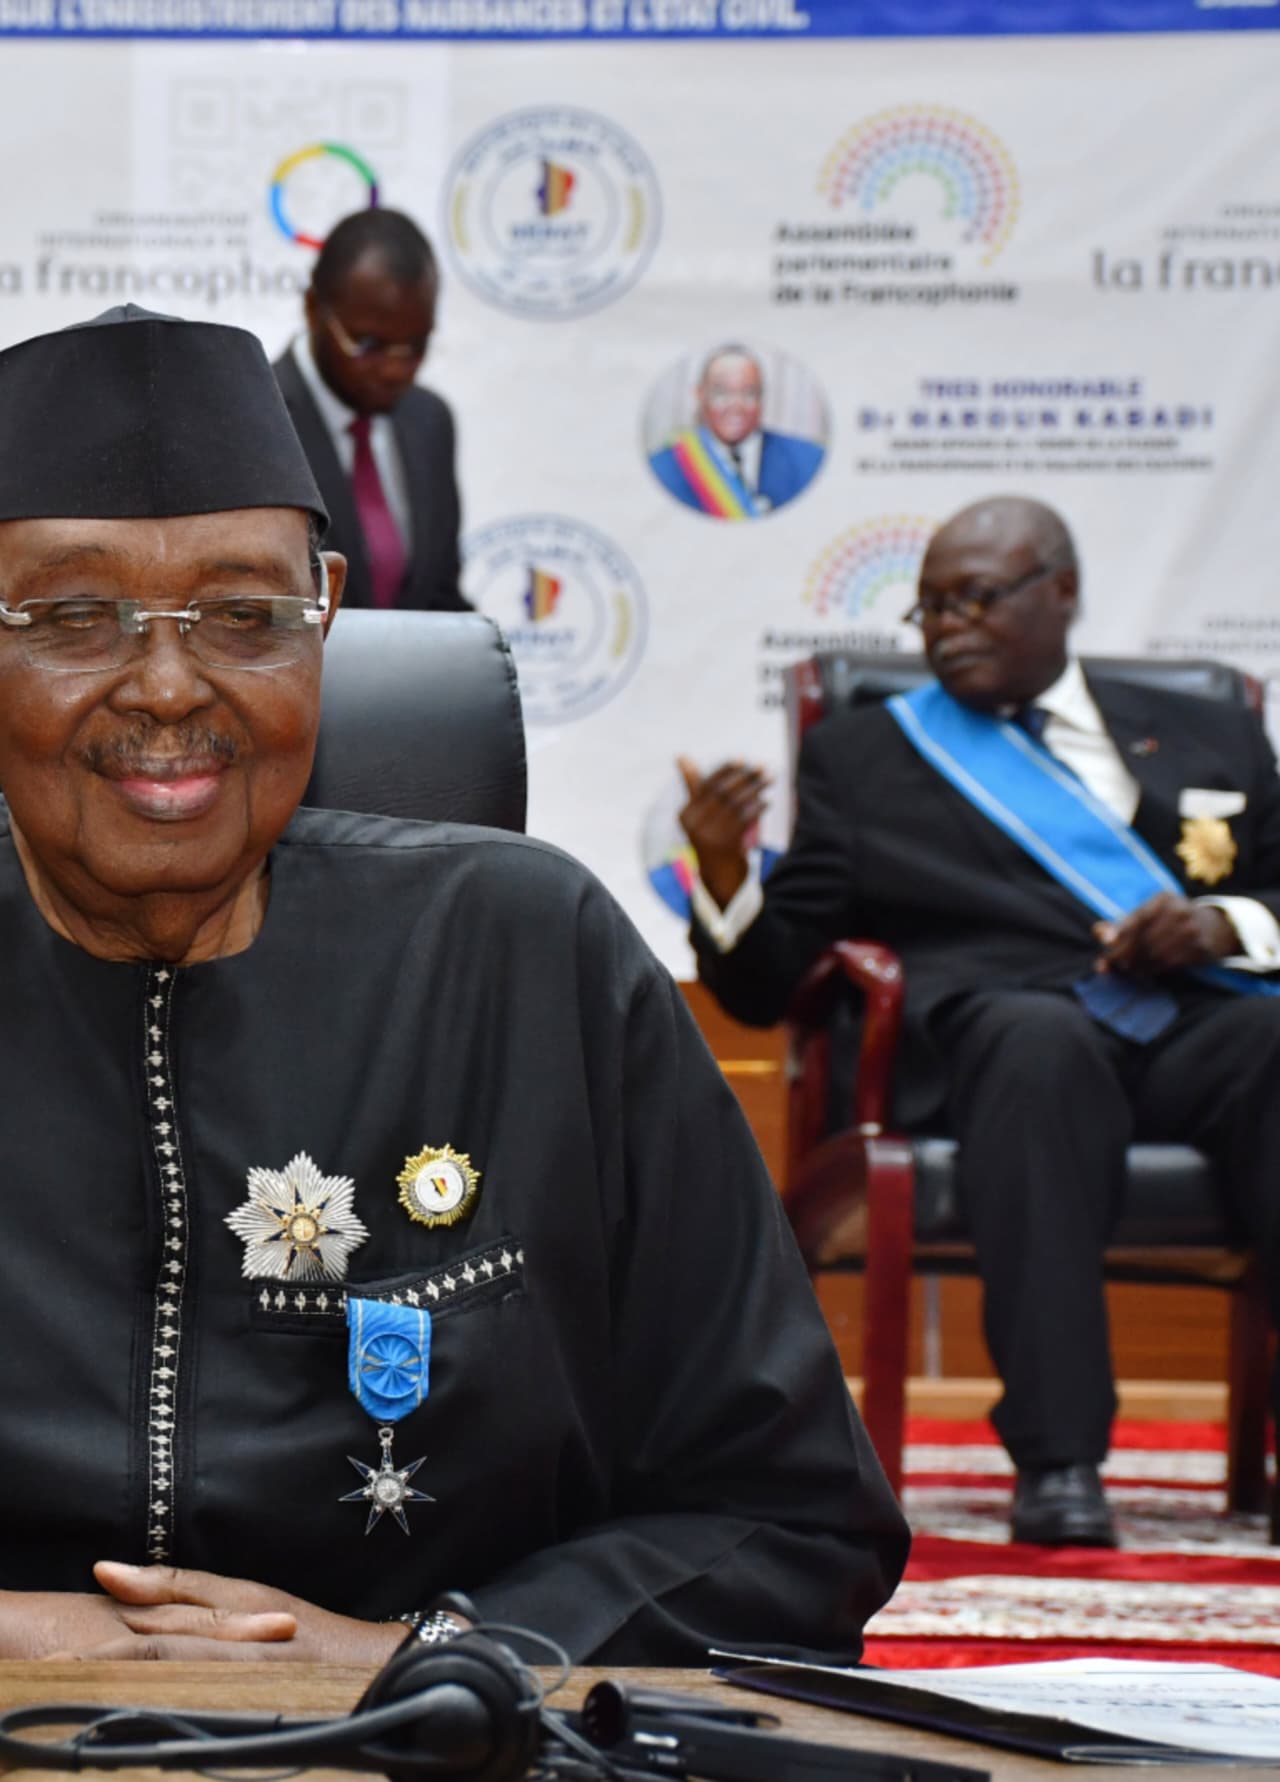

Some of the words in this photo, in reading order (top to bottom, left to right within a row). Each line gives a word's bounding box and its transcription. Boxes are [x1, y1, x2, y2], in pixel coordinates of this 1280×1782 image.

[34, 252, 312, 304] francopho
[1091, 248, 1144, 292] la
[1157, 247, 1280, 292] fran
